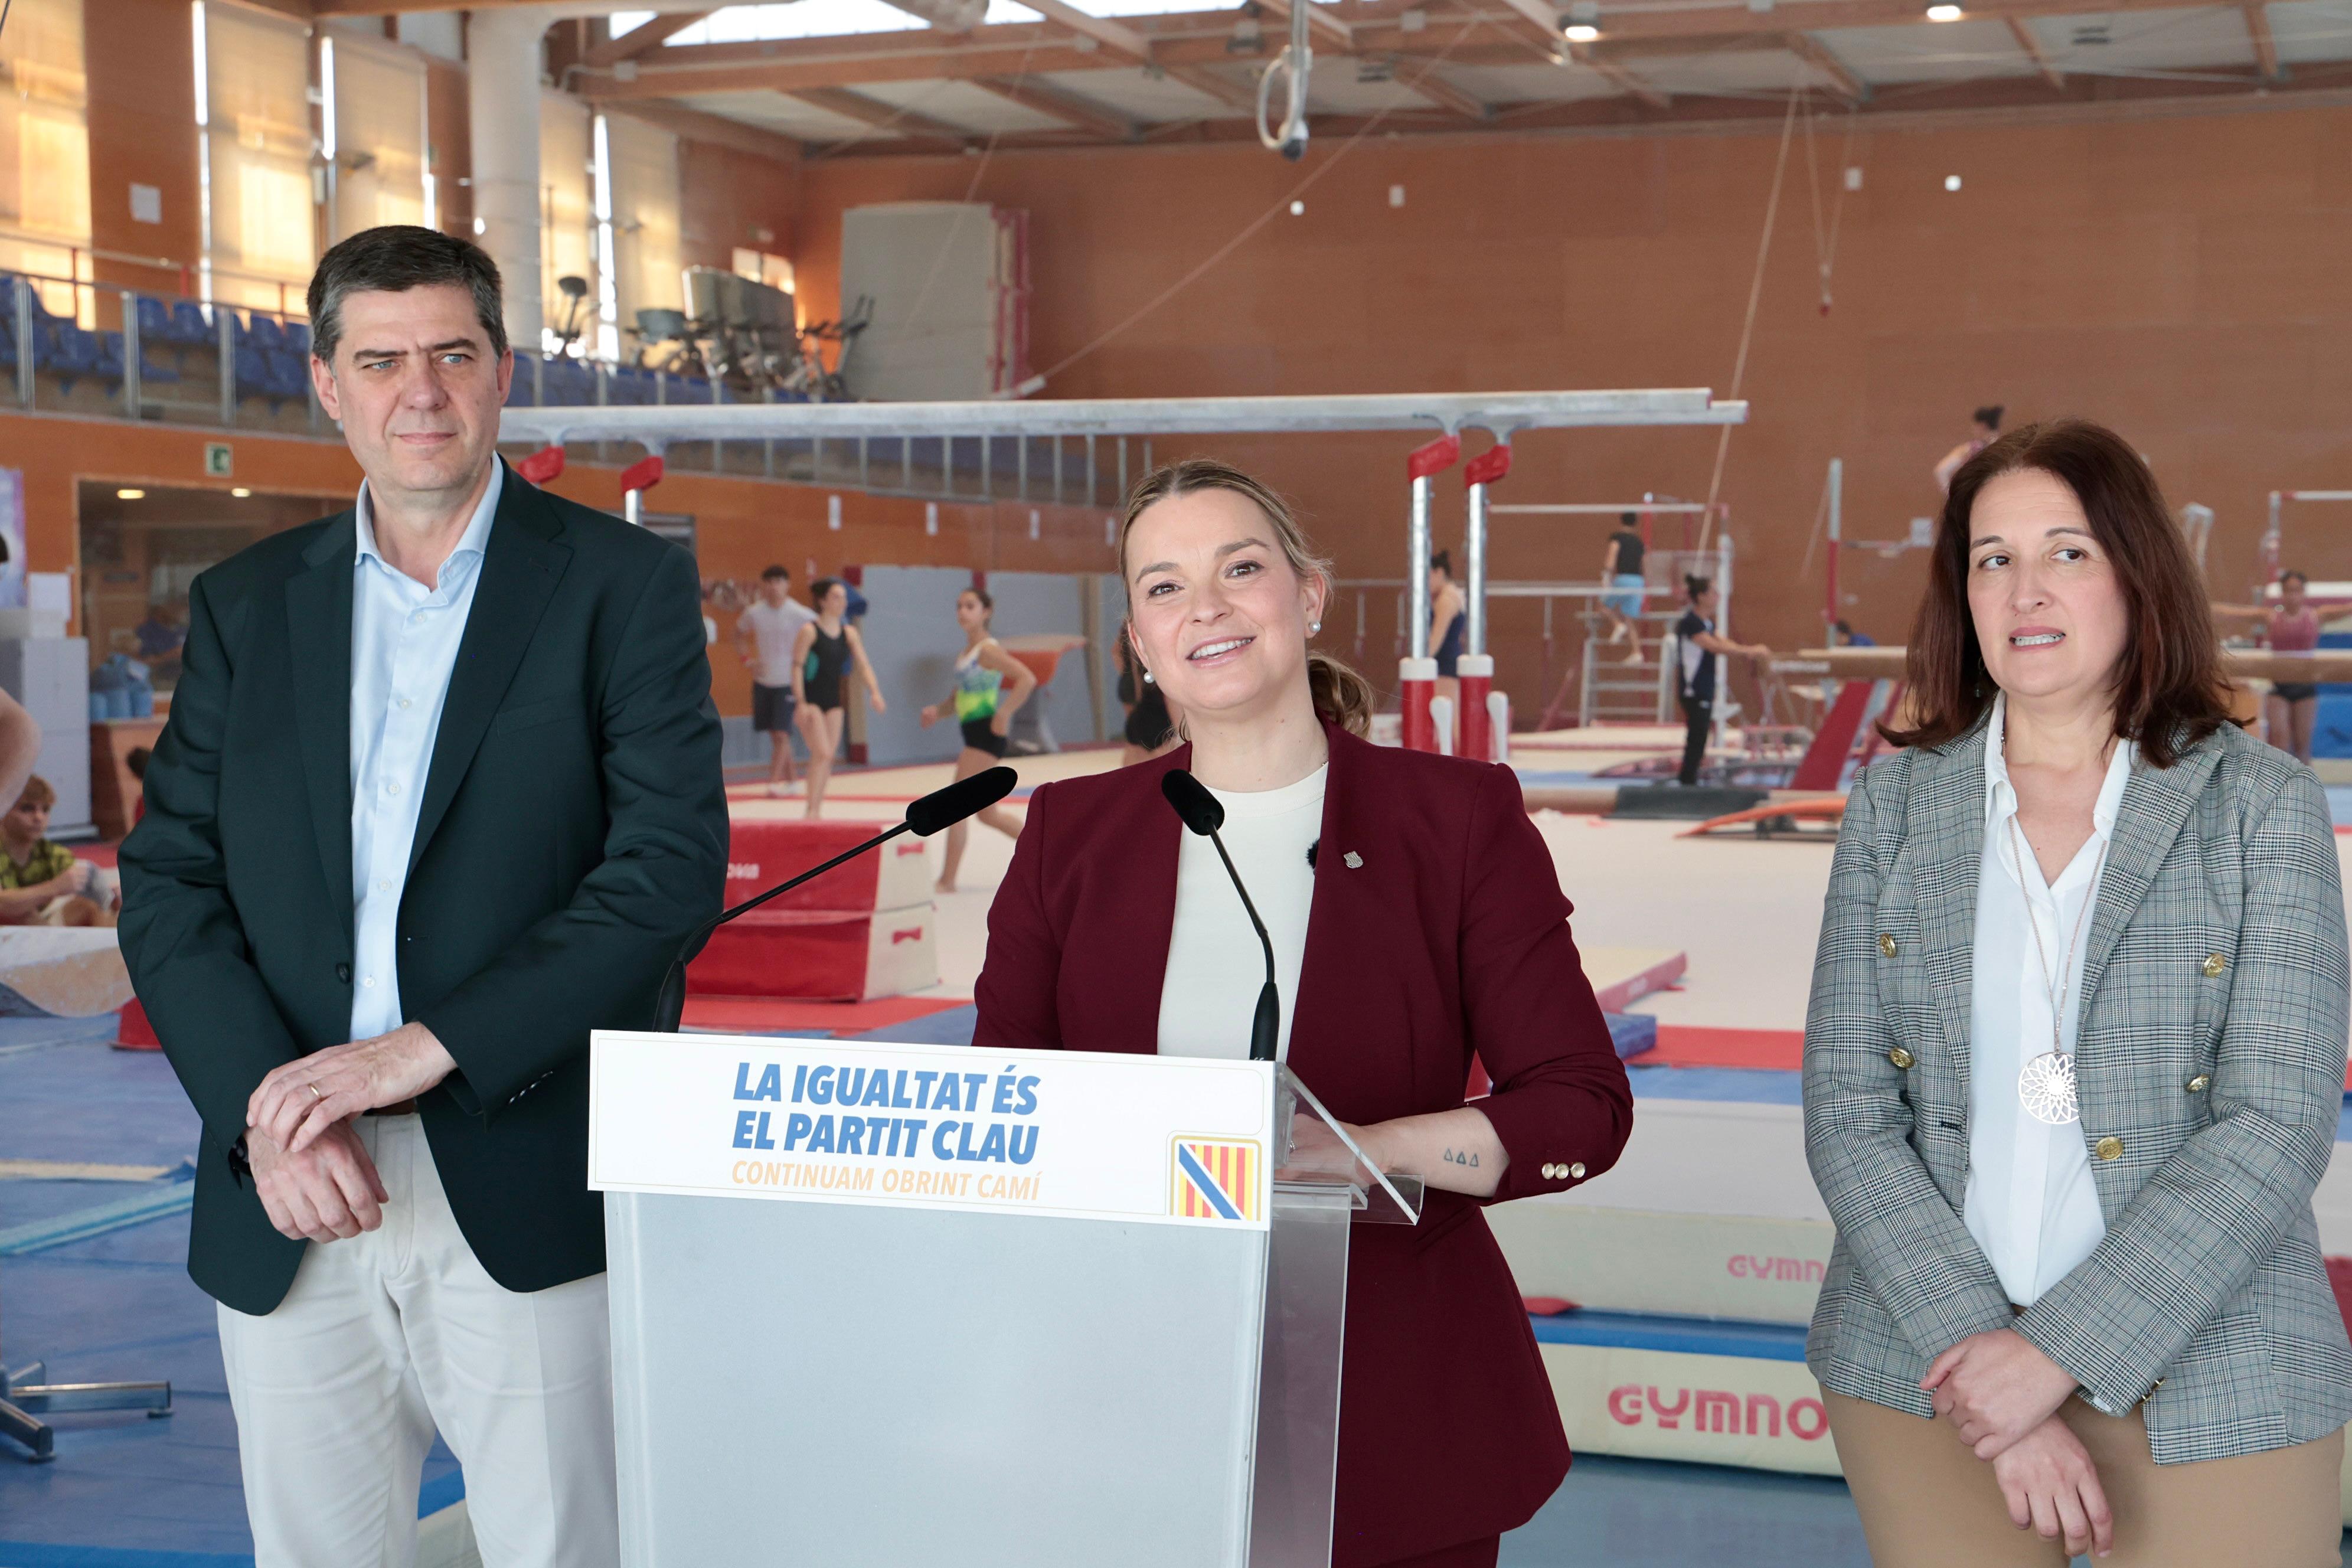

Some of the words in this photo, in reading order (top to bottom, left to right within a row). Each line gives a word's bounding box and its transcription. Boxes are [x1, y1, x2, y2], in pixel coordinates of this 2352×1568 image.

[733, 1062, 782, 1102] LA
[791, 1064, 988, 1112] IGUALTAT
[991, 1063, 1041, 1115] ÉS
[731, 1110, 775, 1151] EL
[783, 1112, 927, 1159] PARTIT
[932, 1120, 1040, 1165] CLAU
[732, 1160, 876, 1191] CONTINUAM
[881, 1168, 973, 1197] OBRINT
[978, 1171, 1041, 1201] CAMÍ
